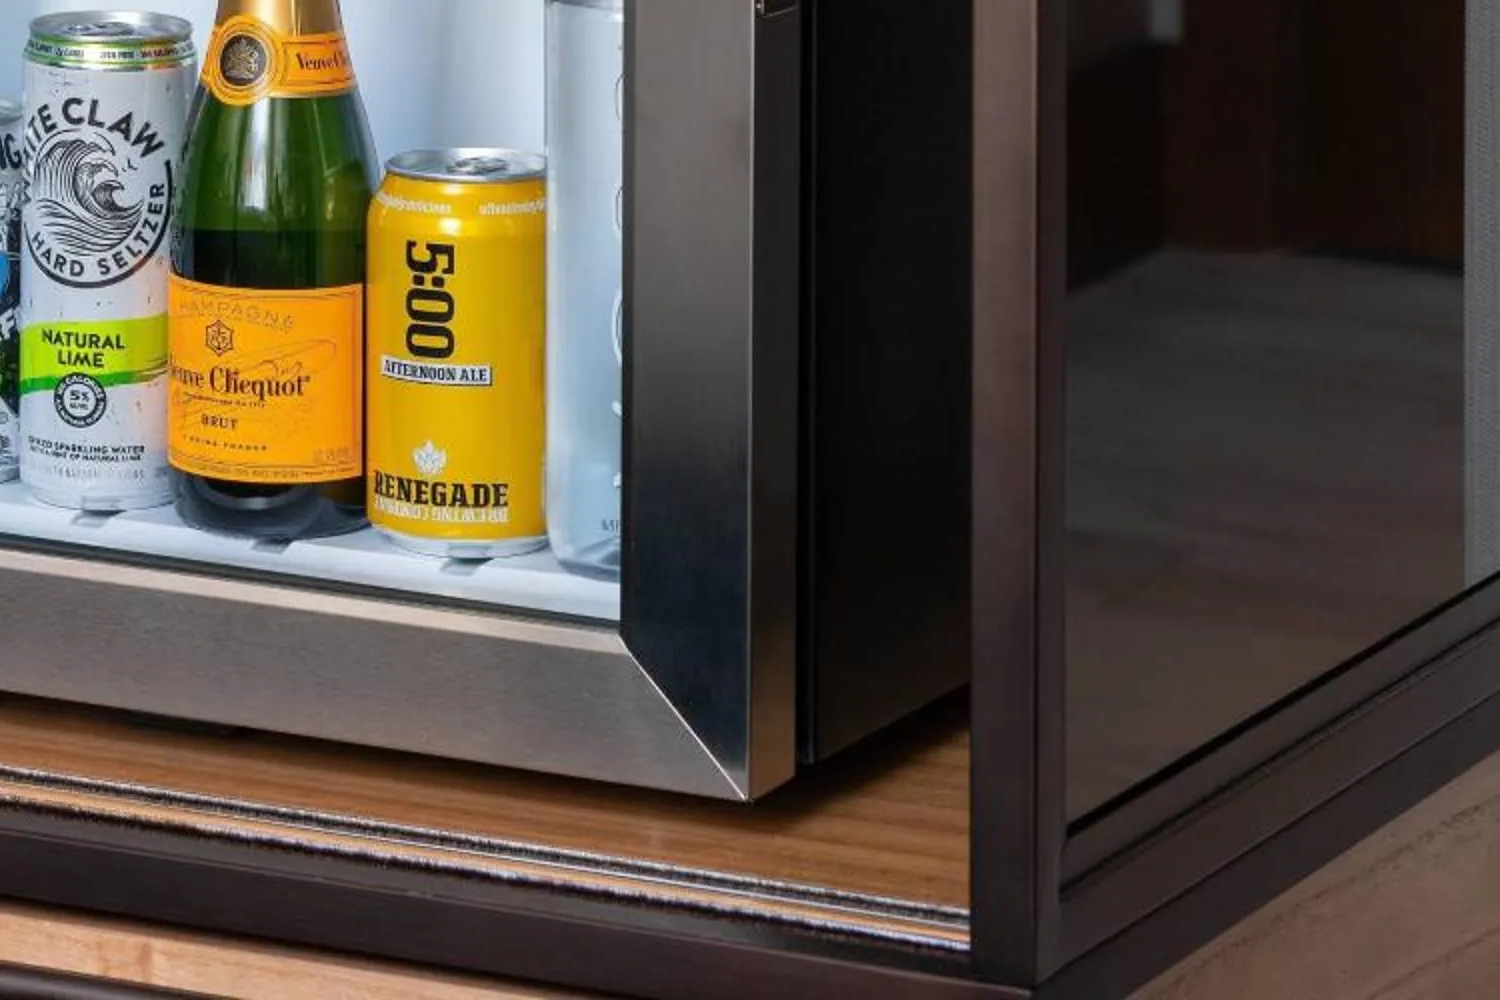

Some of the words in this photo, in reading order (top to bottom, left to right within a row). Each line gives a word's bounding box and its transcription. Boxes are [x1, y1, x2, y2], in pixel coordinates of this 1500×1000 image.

[62, 97, 165, 157] CLAW
[31, 232, 84, 277] HARD
[97, 182, 165, 275] SELTZER
[177, 298, 294, 330] HAMPAGNE
[405, 239, 455, 359] 5:00
[42, 328, 125, 350] NATURAL
[58, 350, 104, 368] LIME
[384, 358, 456, 382] AFTERNOON
[460, 366, 487, 382] ALE
[210, 365, 306, 401] Clicquot
[201, 413, 238, 430] BRUT
[374, 469, 509, 507] RENEGADE
